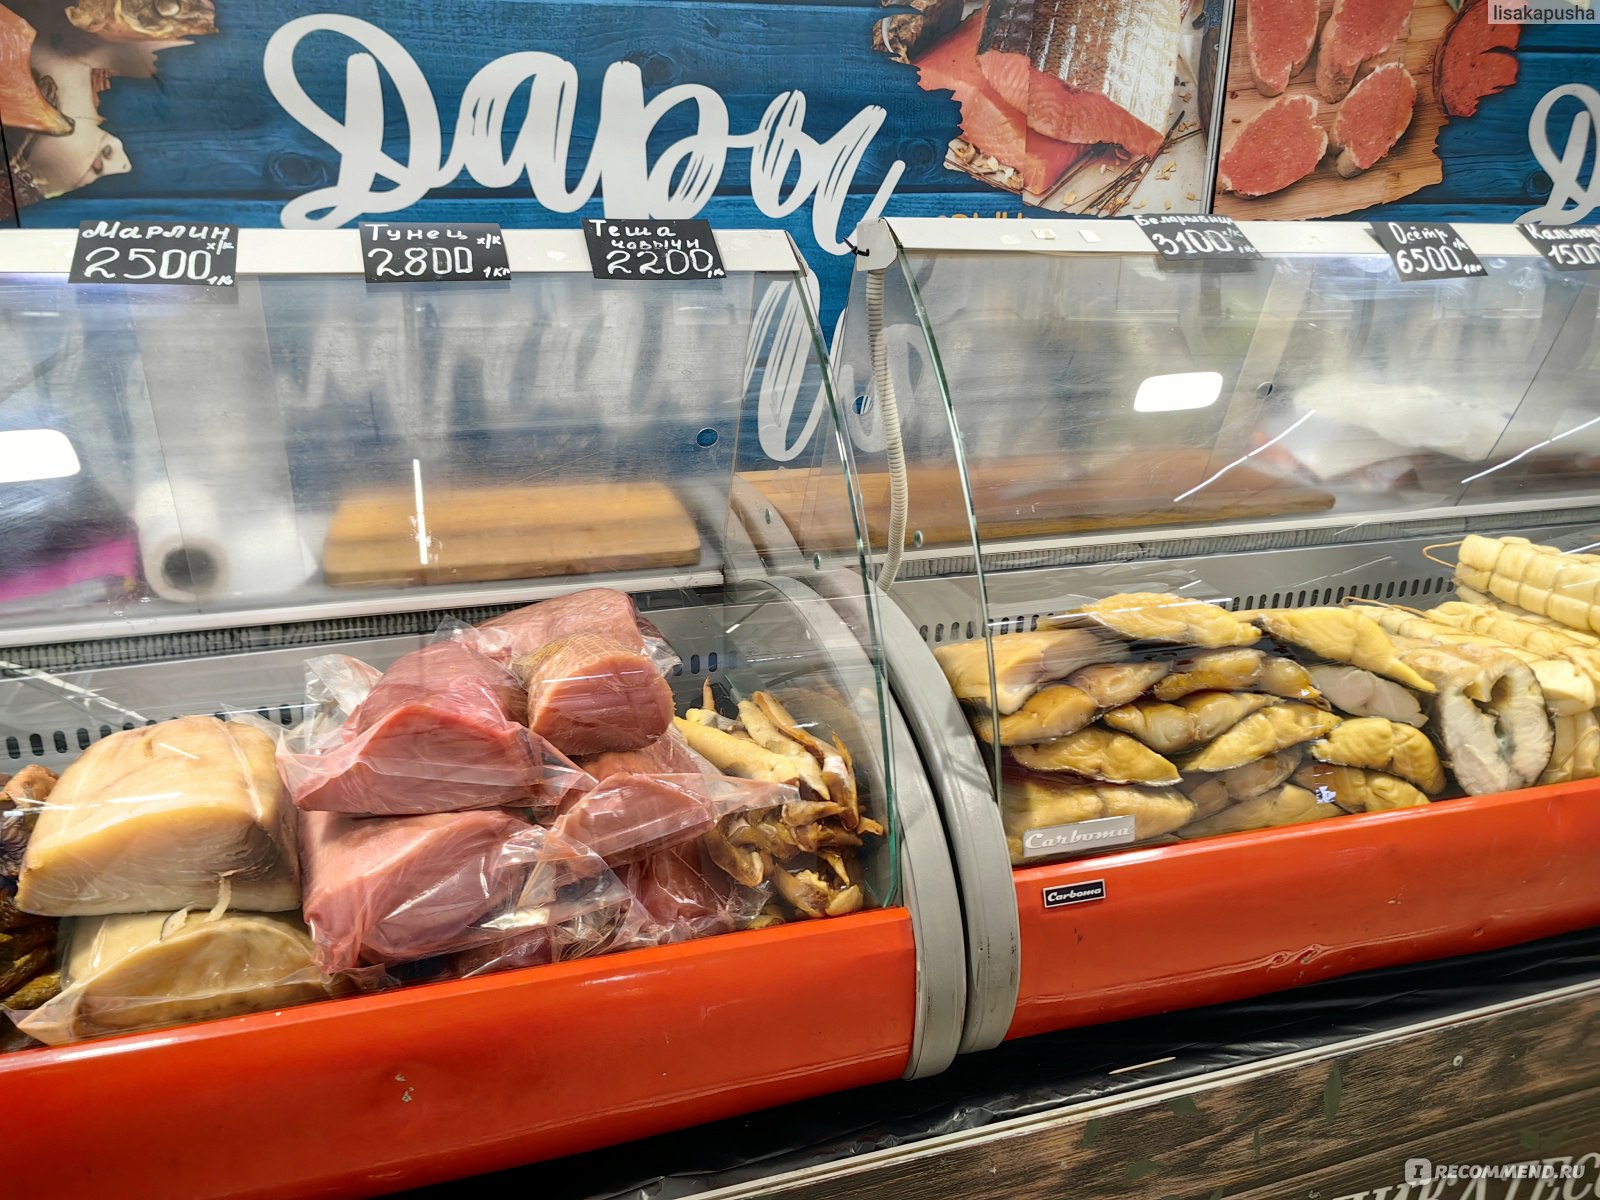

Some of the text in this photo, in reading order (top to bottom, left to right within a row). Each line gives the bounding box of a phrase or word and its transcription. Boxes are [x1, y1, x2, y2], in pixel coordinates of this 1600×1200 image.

[82, 221, 230, 239] Марлин
[364, 224, 468, 241] Тунец
[588, 219, 676, 237] Теша
[1152, 229, 1235, 255] 3100
[84, 247, 211, 279] 2500
[368, 246, 473, 277] 2800
[606, 249, 714, 275] 2200
[1396, 245, 1463, 274] 6500
[1025, 826, 1131, 849] Carboma
[1047, 887, 1102, 902] Carboma
